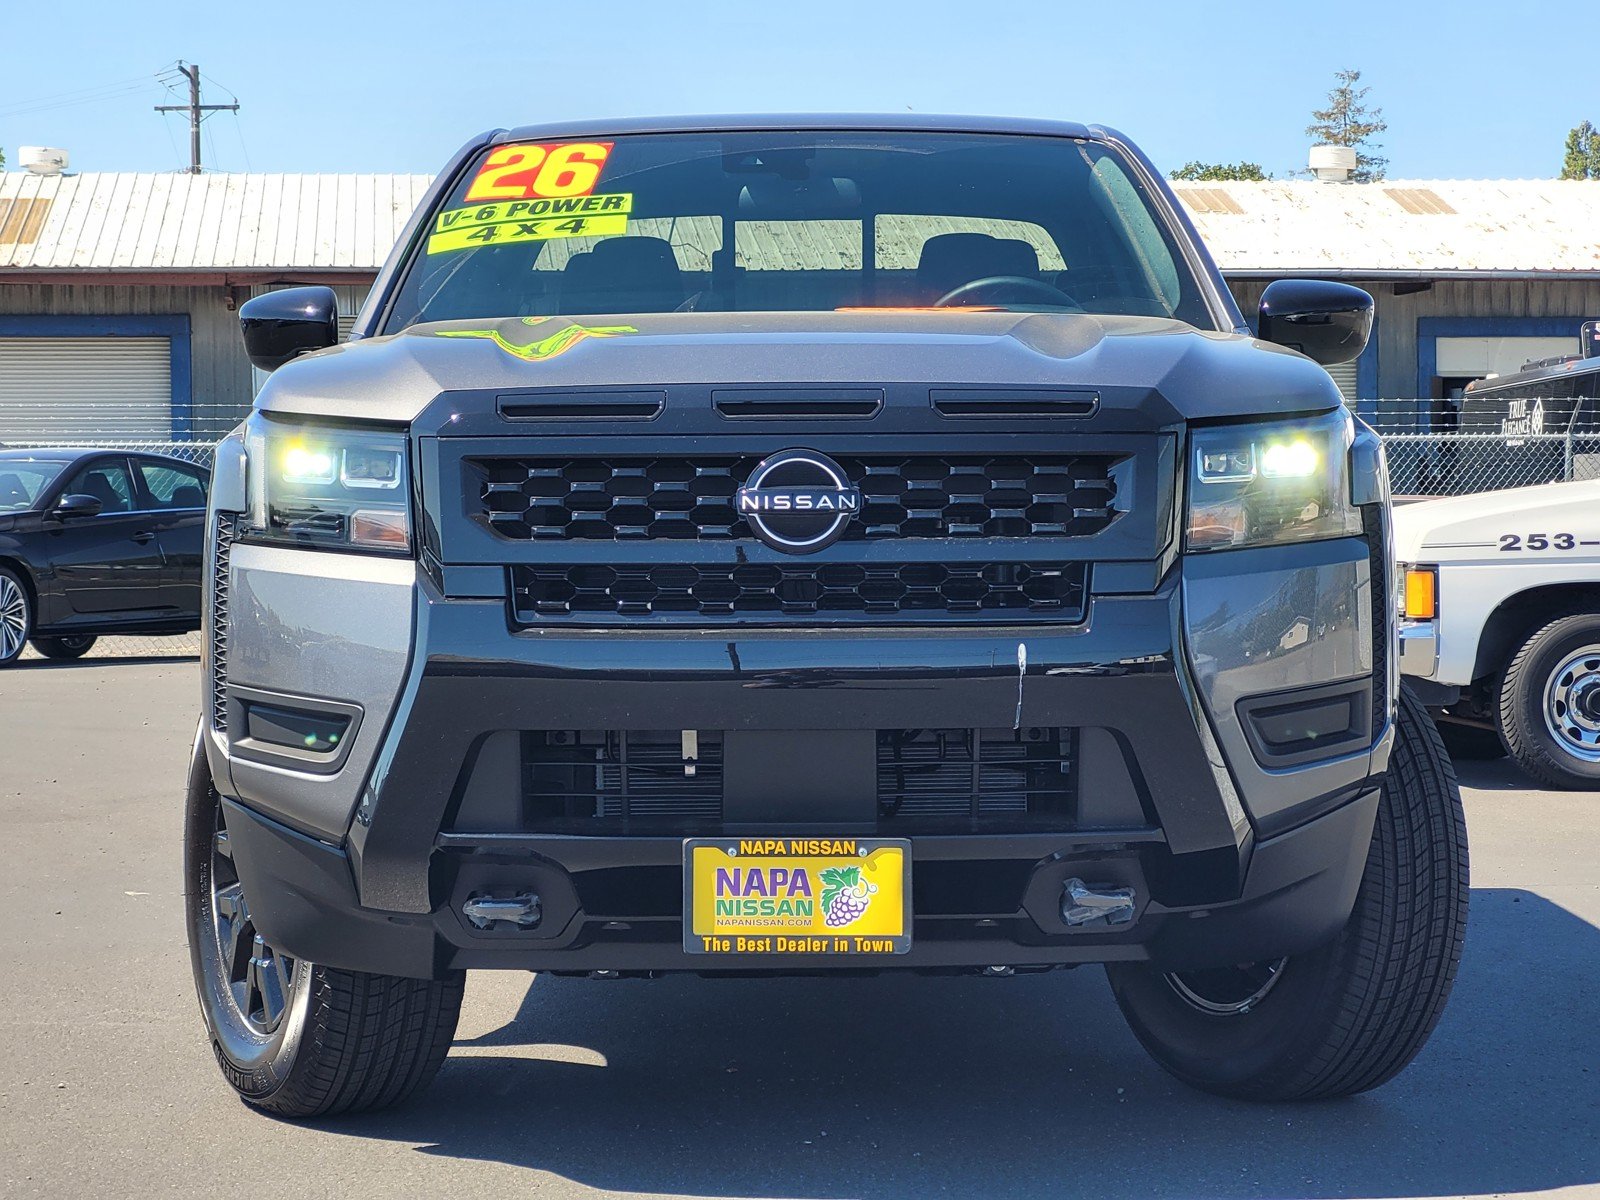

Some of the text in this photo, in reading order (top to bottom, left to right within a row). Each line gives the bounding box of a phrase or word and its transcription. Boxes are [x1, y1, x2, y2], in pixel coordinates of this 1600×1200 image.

[468, 144, 608, 198] 26
[442, 196, 624, 227] V-6 POWER
[466, 225, 500, 242] 4
[554, 218, 590, 234] 4
[1508, 399, 1528, 419] TRUE
[741, 494, 856, 510] NISSAN
[740, 841, 856, 855] NAPA NISSAN
[716, 868, 812, 897] NAPA
[716, 899, 813, 916] NISSAN
[716, 918, 812, 926] NAPANISSAN.COM
[703, 937, 894, 952] The Best Dealer in Town
